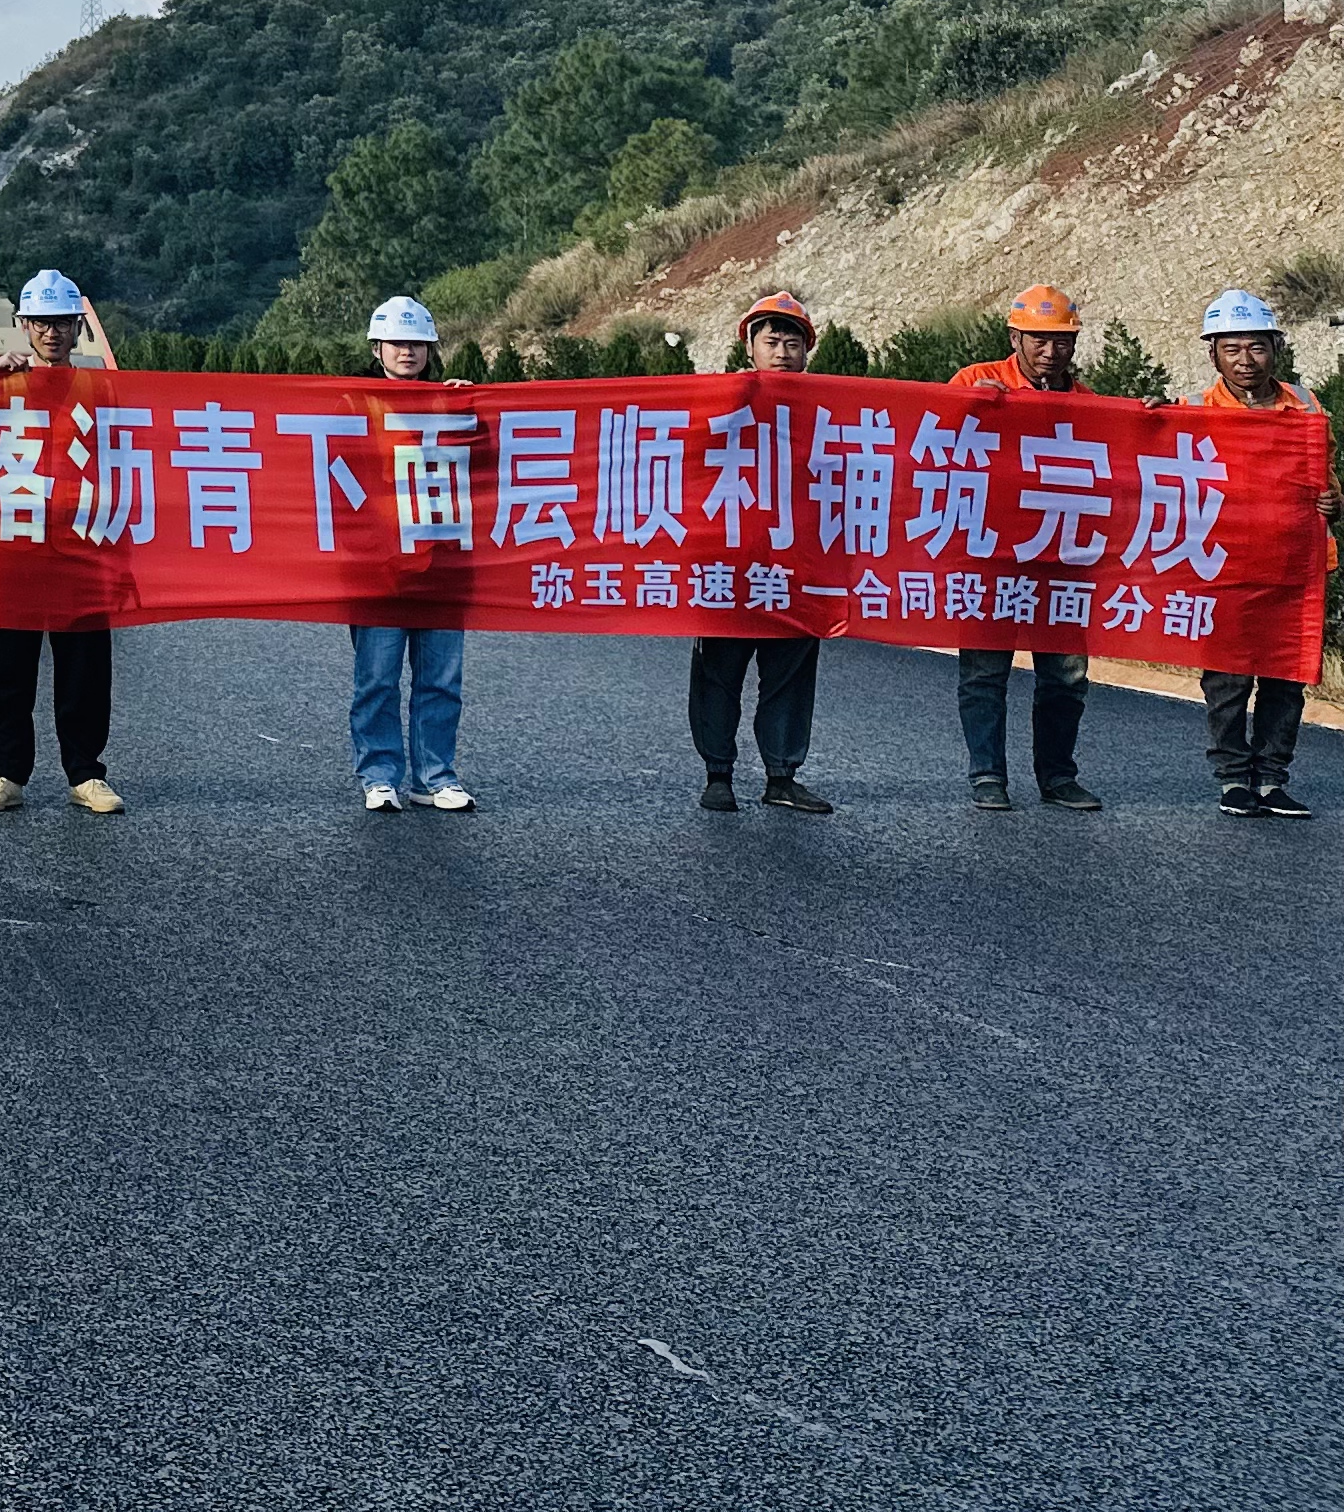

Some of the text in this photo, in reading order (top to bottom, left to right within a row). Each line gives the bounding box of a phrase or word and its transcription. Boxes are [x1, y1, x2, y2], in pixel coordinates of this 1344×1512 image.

[530, 560, 1218, 641] 弥玉高速第一合同段路面分部
